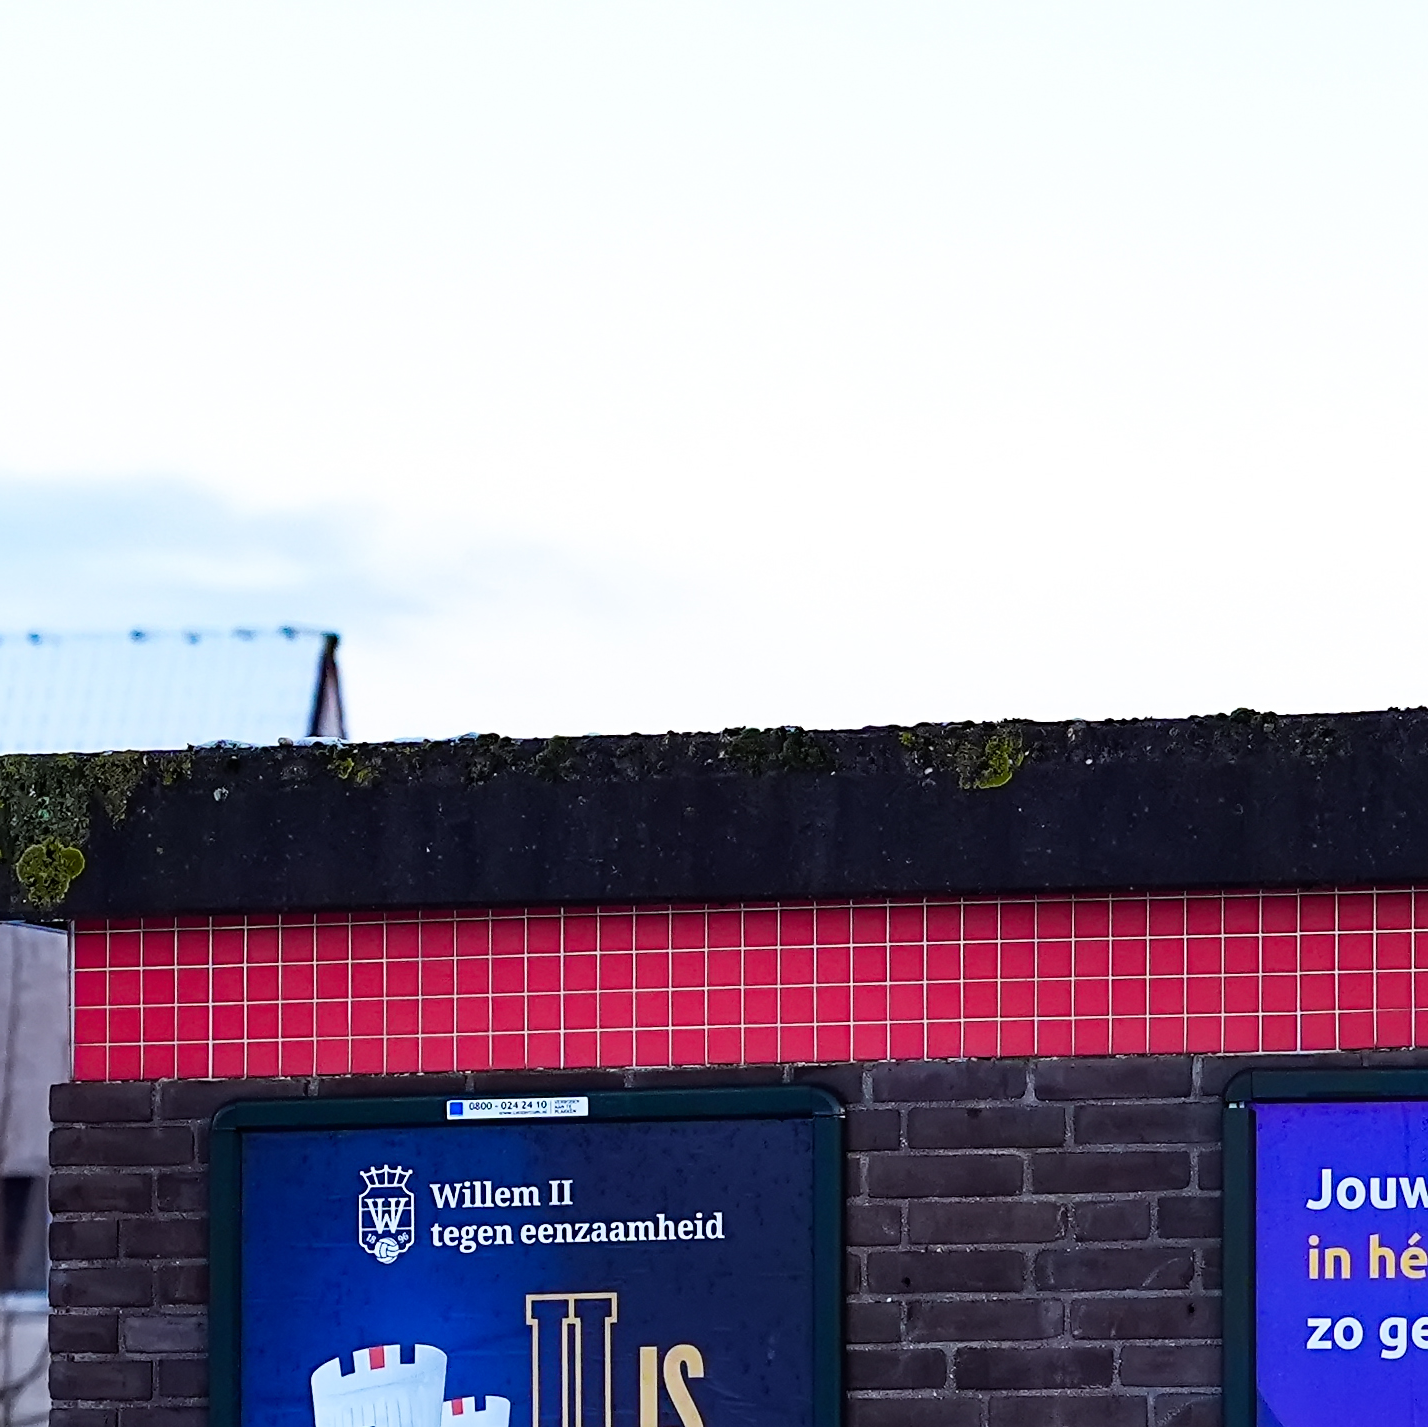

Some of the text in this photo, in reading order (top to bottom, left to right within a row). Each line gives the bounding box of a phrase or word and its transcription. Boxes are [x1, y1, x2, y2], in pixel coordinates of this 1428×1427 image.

[469, 1102, 493, 1111] 0800
[500, 1101, 518, 1110] 024
[522, 1101, 533, 1109] 24
[536, 1100, 547, 1109] 10
[429, 1179, 573, 1210] Willem II
[364, 1198, 409, 1234] W
[430, 1212, 725, 1254] tegen eenzaamheid
[1307, 1235, 1351, 1280] in
[1306, 1314, 1364, 1351] zo
